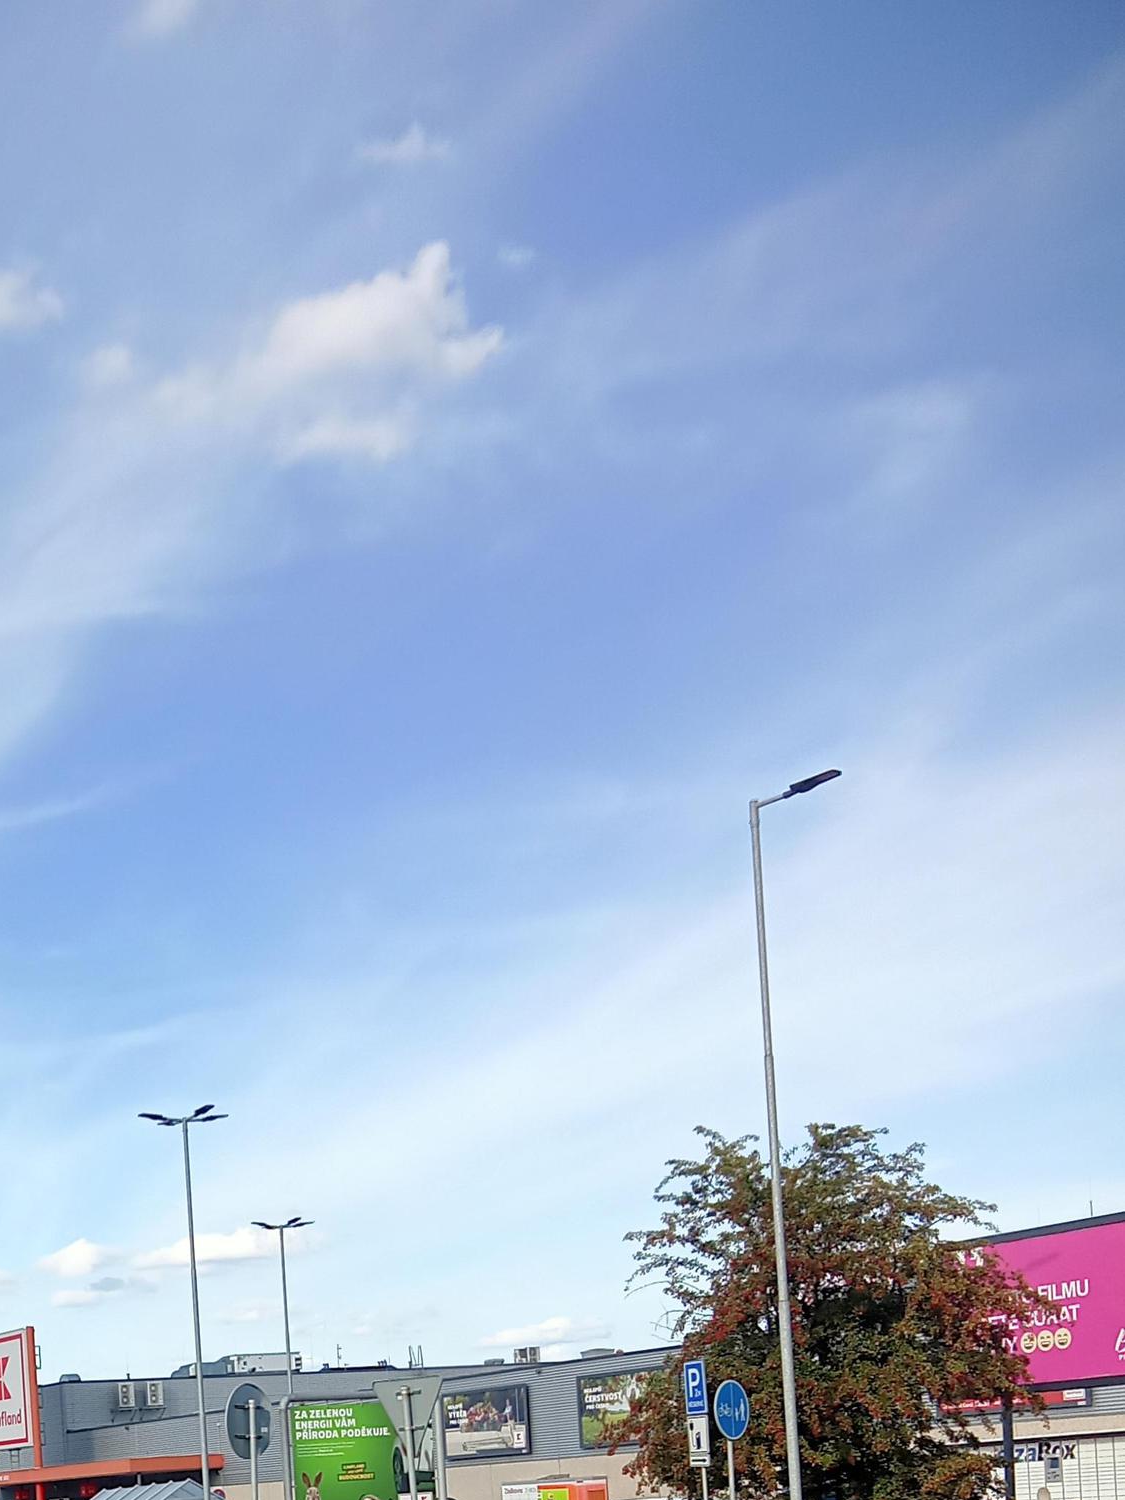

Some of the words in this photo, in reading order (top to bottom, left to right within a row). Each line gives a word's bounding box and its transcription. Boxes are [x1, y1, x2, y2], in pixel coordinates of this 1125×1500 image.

[688, 1368, 700, 1398] P
[294, 1410, 307, 1419] ZA
[309, 1408, 353, 1418] ZELENOU
[295, 1420, 333, 1430] ENERGII
[296, 1428, 339, 1440] PŘÍRODA
[341, 1426, 390, 1438] PODĚKUJE.
